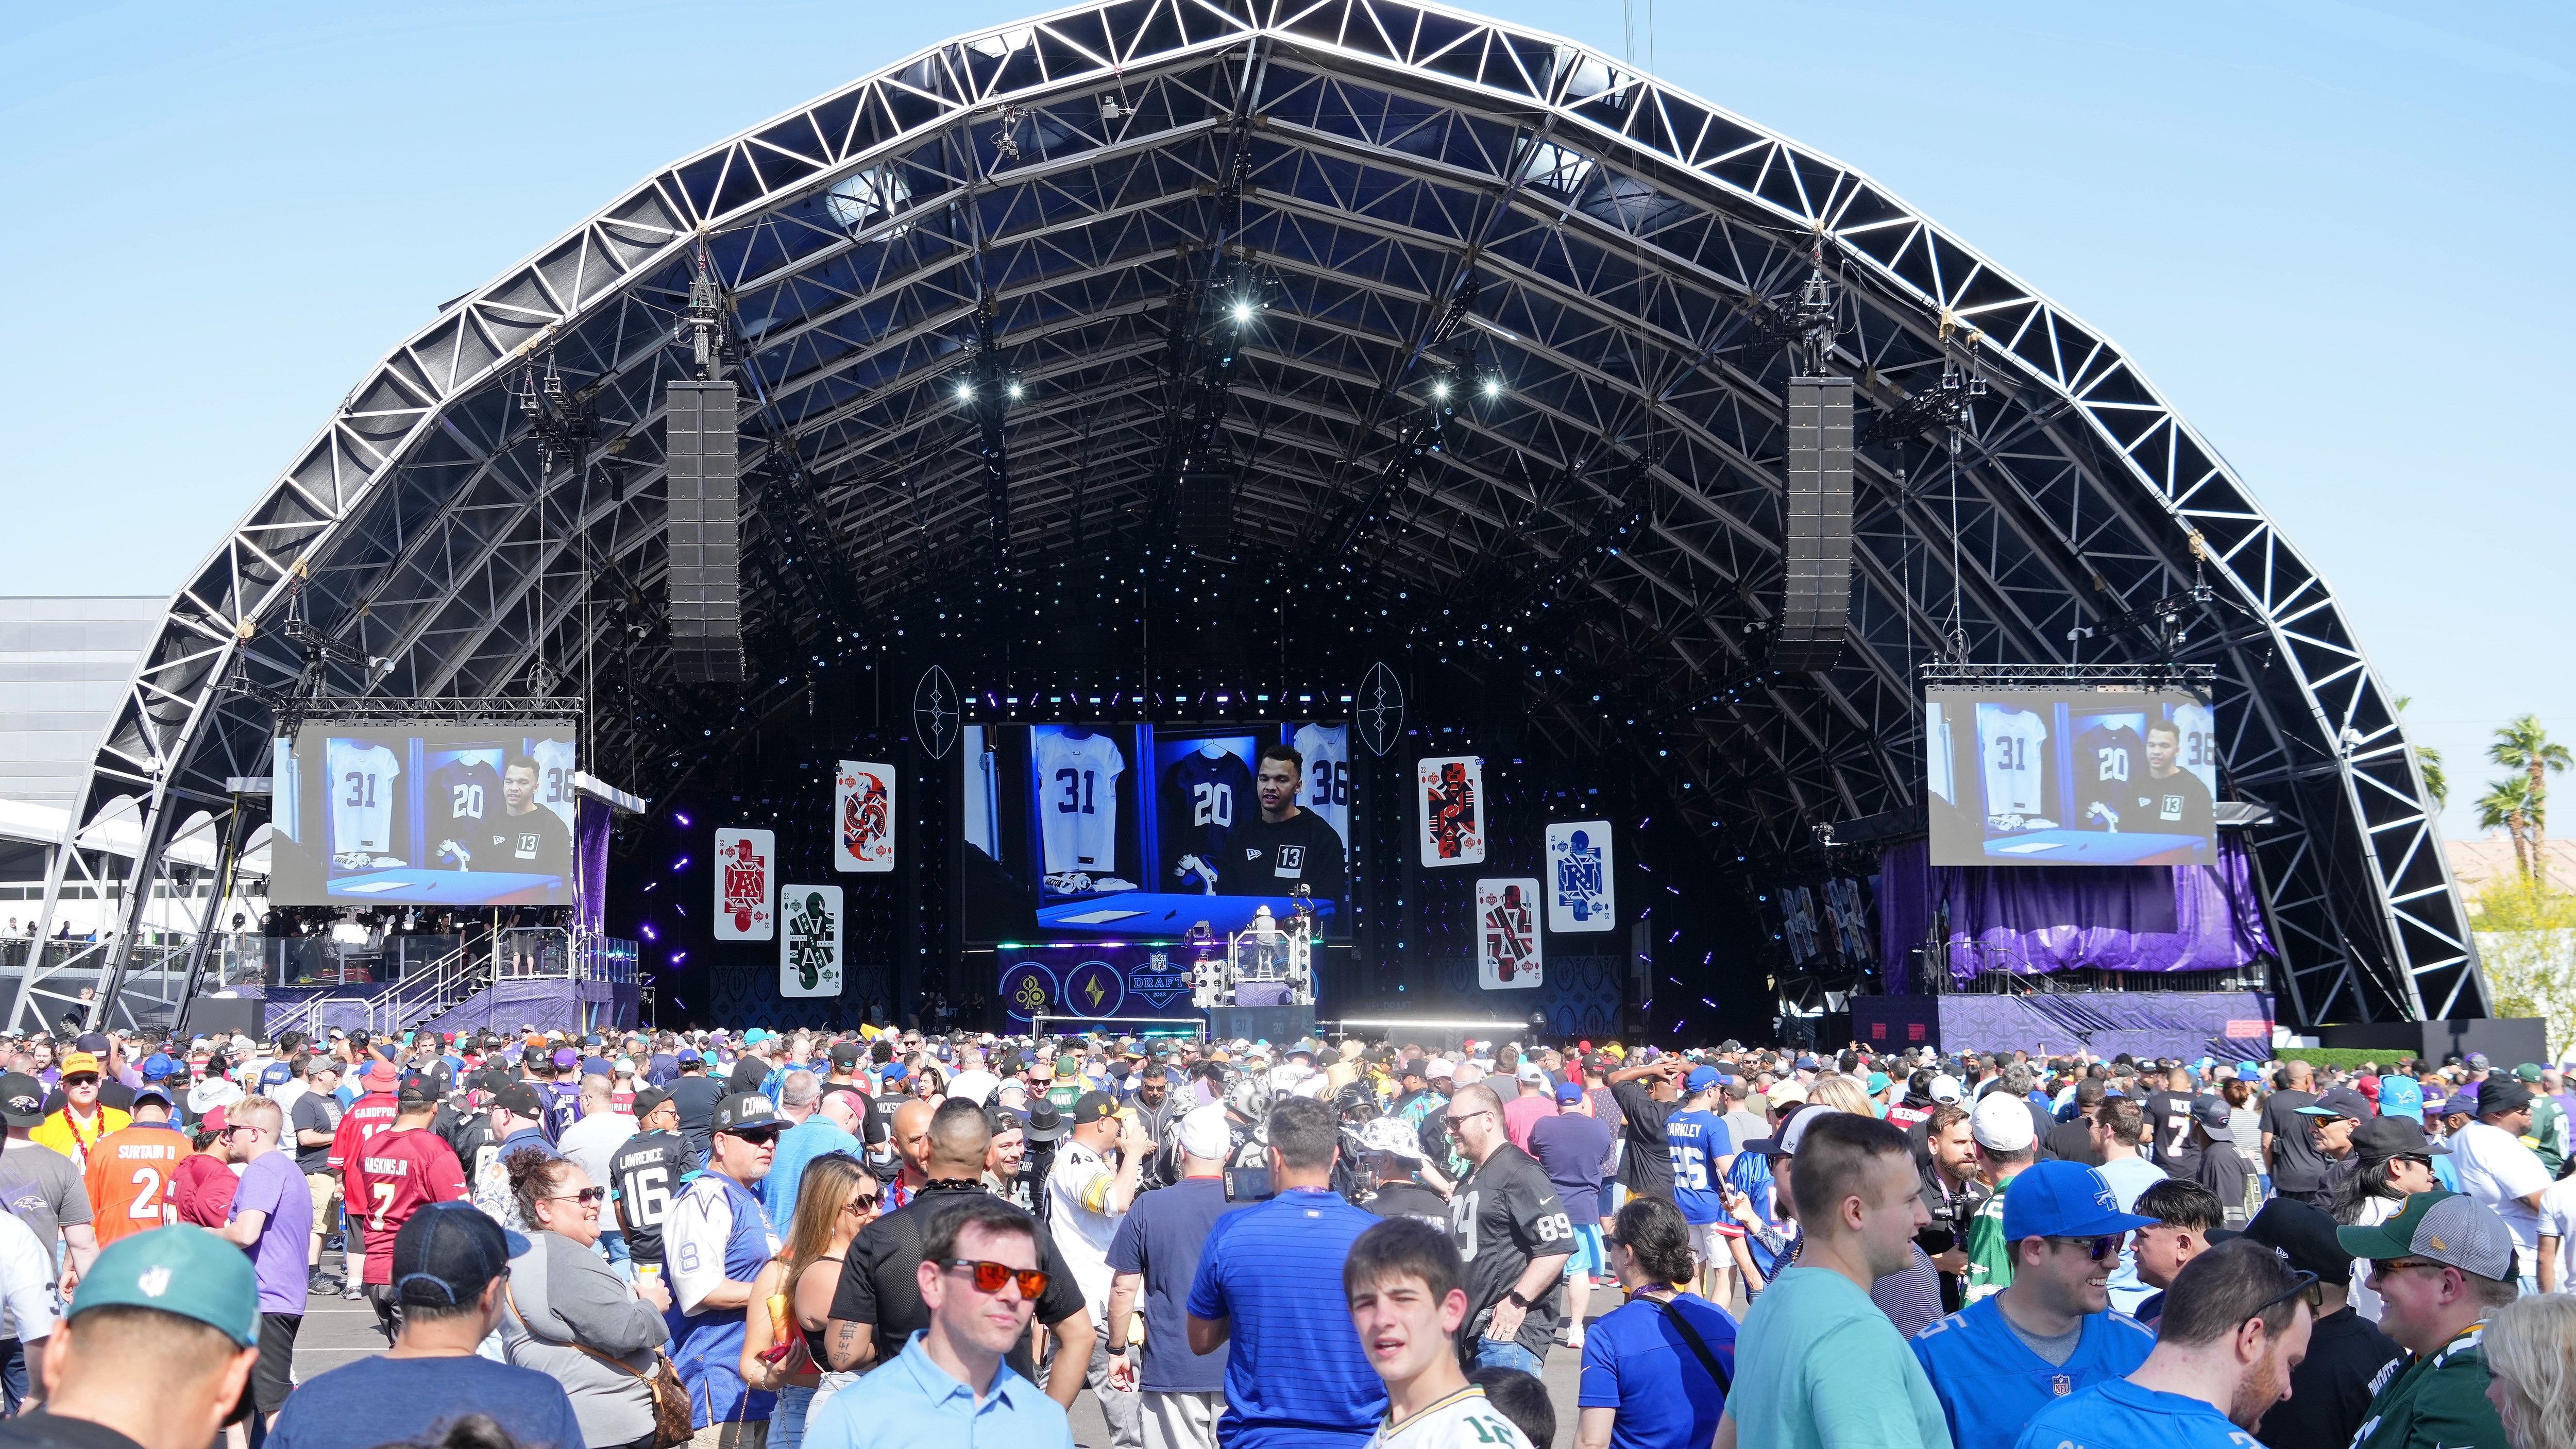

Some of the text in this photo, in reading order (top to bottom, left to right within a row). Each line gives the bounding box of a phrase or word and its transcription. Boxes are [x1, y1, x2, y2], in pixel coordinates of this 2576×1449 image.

[1996, 736, 2025, 770] 31
[2098, 747, 2129, 782] 20
[345, 772, 376, 808] 31
[453, 783, 483, 819] 20
[1056, 768, 1095, 814] 31
[2165, 796, 2180, 812] 13
[1194, 782, 1232, 827] 20
[521, 835, 536, 850] 13
[1281, 848, 1300, 867] 13
[730, 870, 759, 898] A
[1564, 861, 1596, 893] N
[1152, 960, 1167, 970] NFL
[1133, 977, 1184, 988] DRAFT
[355, 1107, 397, 1119] GAROPPOL
[609, 1103, 632, 1112] URRAY
[1051, 1094, 1072, 1105] HAWK
[1667, 1123, 1702, 1137] BARKLEY
[2167, 1115, 2190, 1157] 7
[118, 1145, 176, 1160] SURTAIN II
[365, 1157, 408, 1176] HASKINS JR
[619, 1148, 664, 1169] LAWRENCE
[1018, 1161, 1033, 1172] CARR
[1669, 1146, 1708, 1189] 26
[129, 1167, 160, 1219] 2
[371, 1183, 395, 1231] 7
[624, 1167, 671, 1228] 16
[1537, 1213, 1573, 1242] 89
[679, 1240, 701, 1274] 8
[2055, 1384, 2068, 1393] NFL
